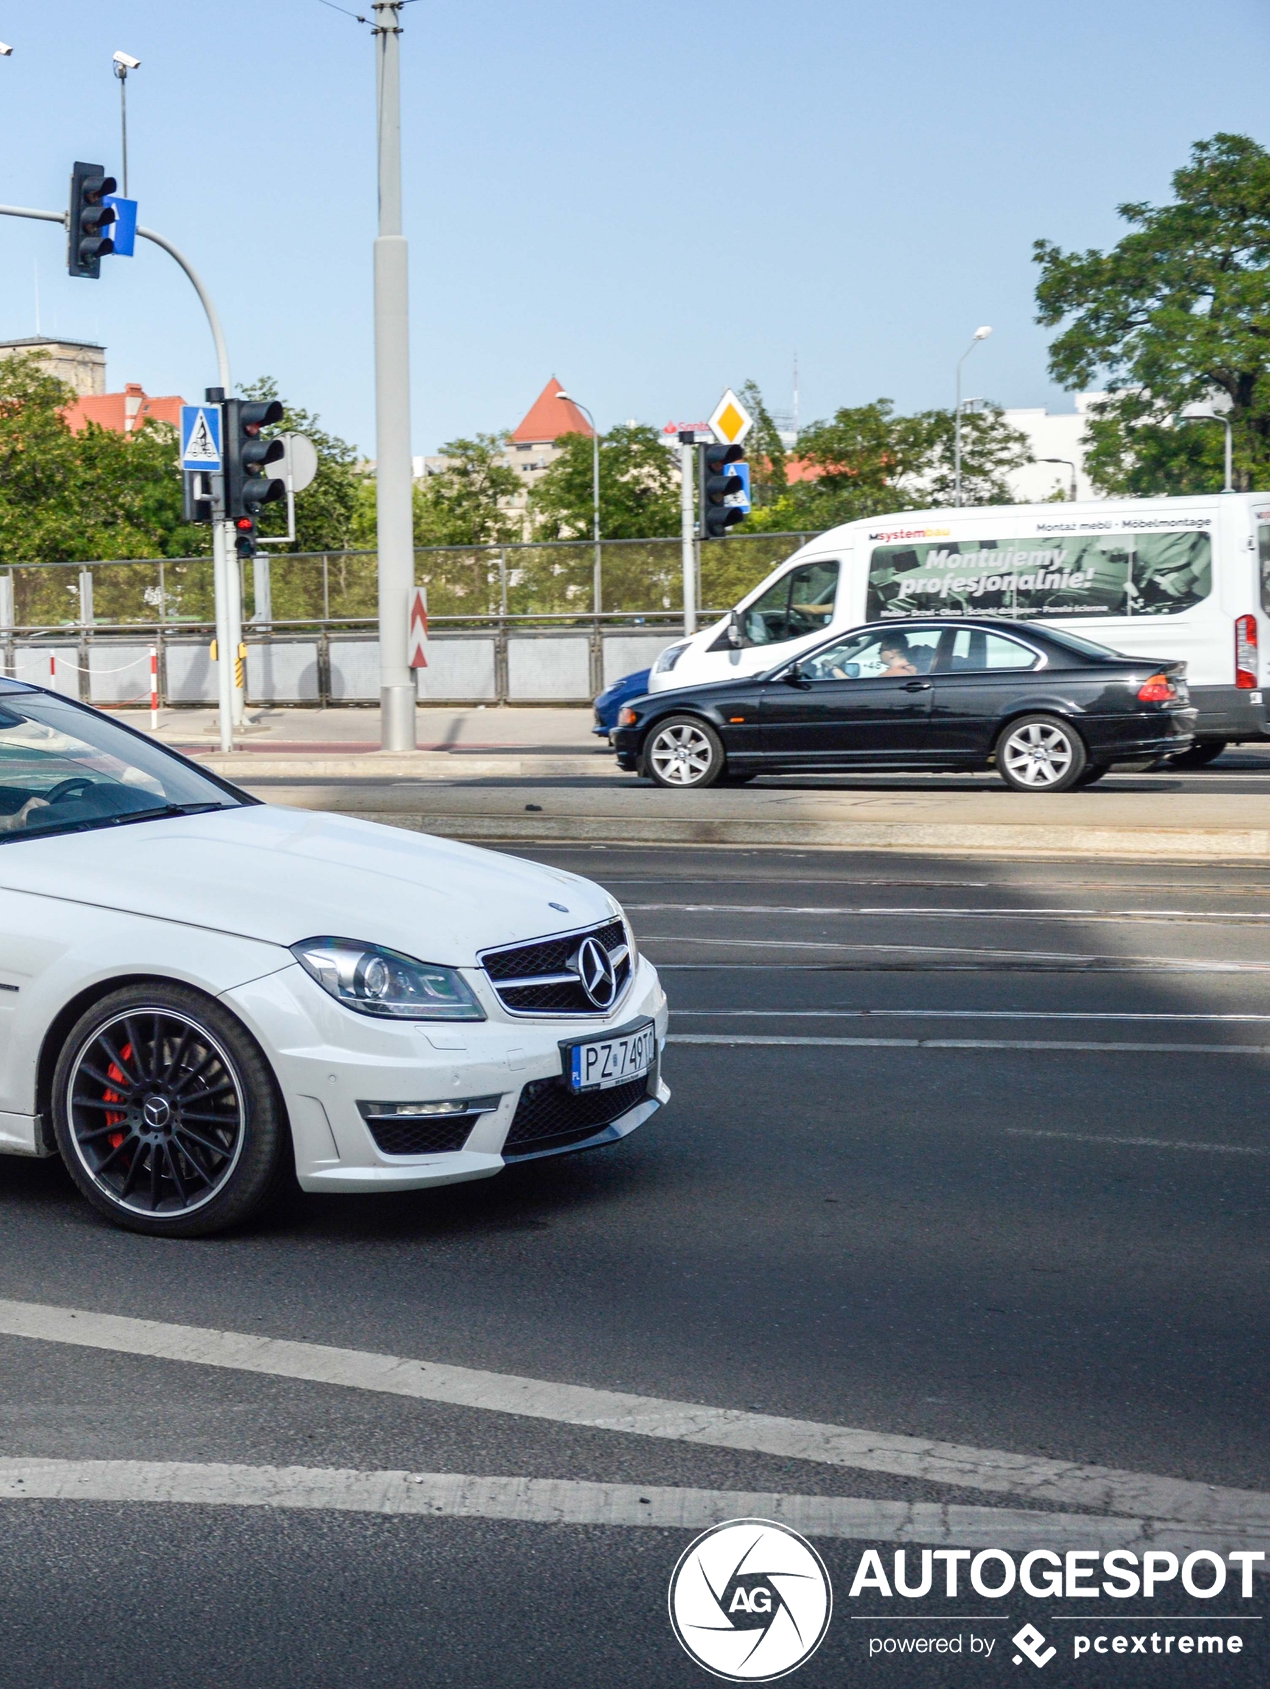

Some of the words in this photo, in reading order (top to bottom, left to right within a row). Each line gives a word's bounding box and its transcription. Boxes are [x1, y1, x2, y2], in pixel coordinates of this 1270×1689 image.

[1036, 521, 1077, 532] Montaż
[1079, 519, 1112, 530] mebli
[1121, 517, 1211, 530] Möbelmontage
[925, 546, 1067, 571] Montujemy
[898, 567, 1095, 598] profesjonalnie!
[586, 1043, 613, 1081] PZ
